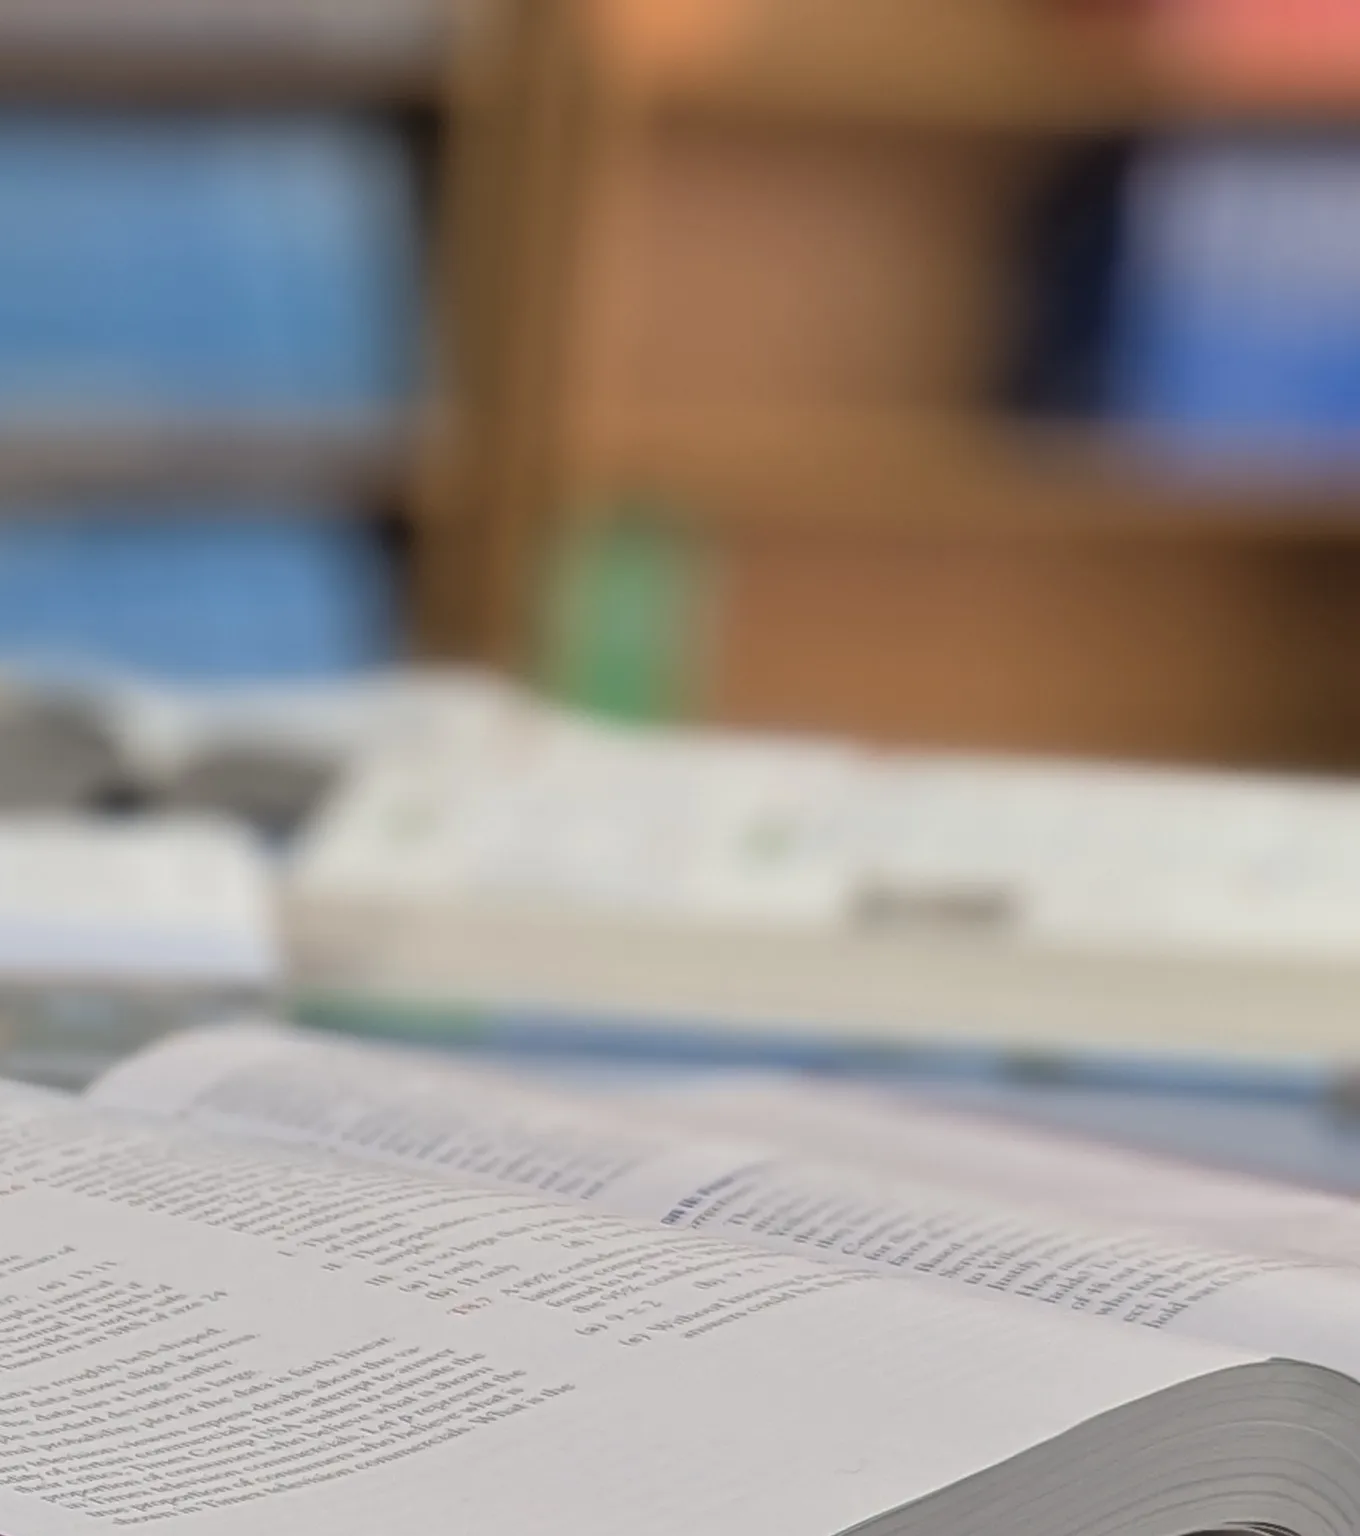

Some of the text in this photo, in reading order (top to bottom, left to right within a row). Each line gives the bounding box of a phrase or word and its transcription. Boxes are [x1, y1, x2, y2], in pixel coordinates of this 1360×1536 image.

[188, 1437, 256, 1459] Group
[252, 1420, 301, 1442] USA
[451, 1351, 488, 1367] the
[489, 1366, 527, 1385] the
[353, 1424, 477, 1471] commercials.
[472, 1412, 521, 1427] What
[540, 1382, 577, 1401] the
[390, 1412, 463, 1444] believe
